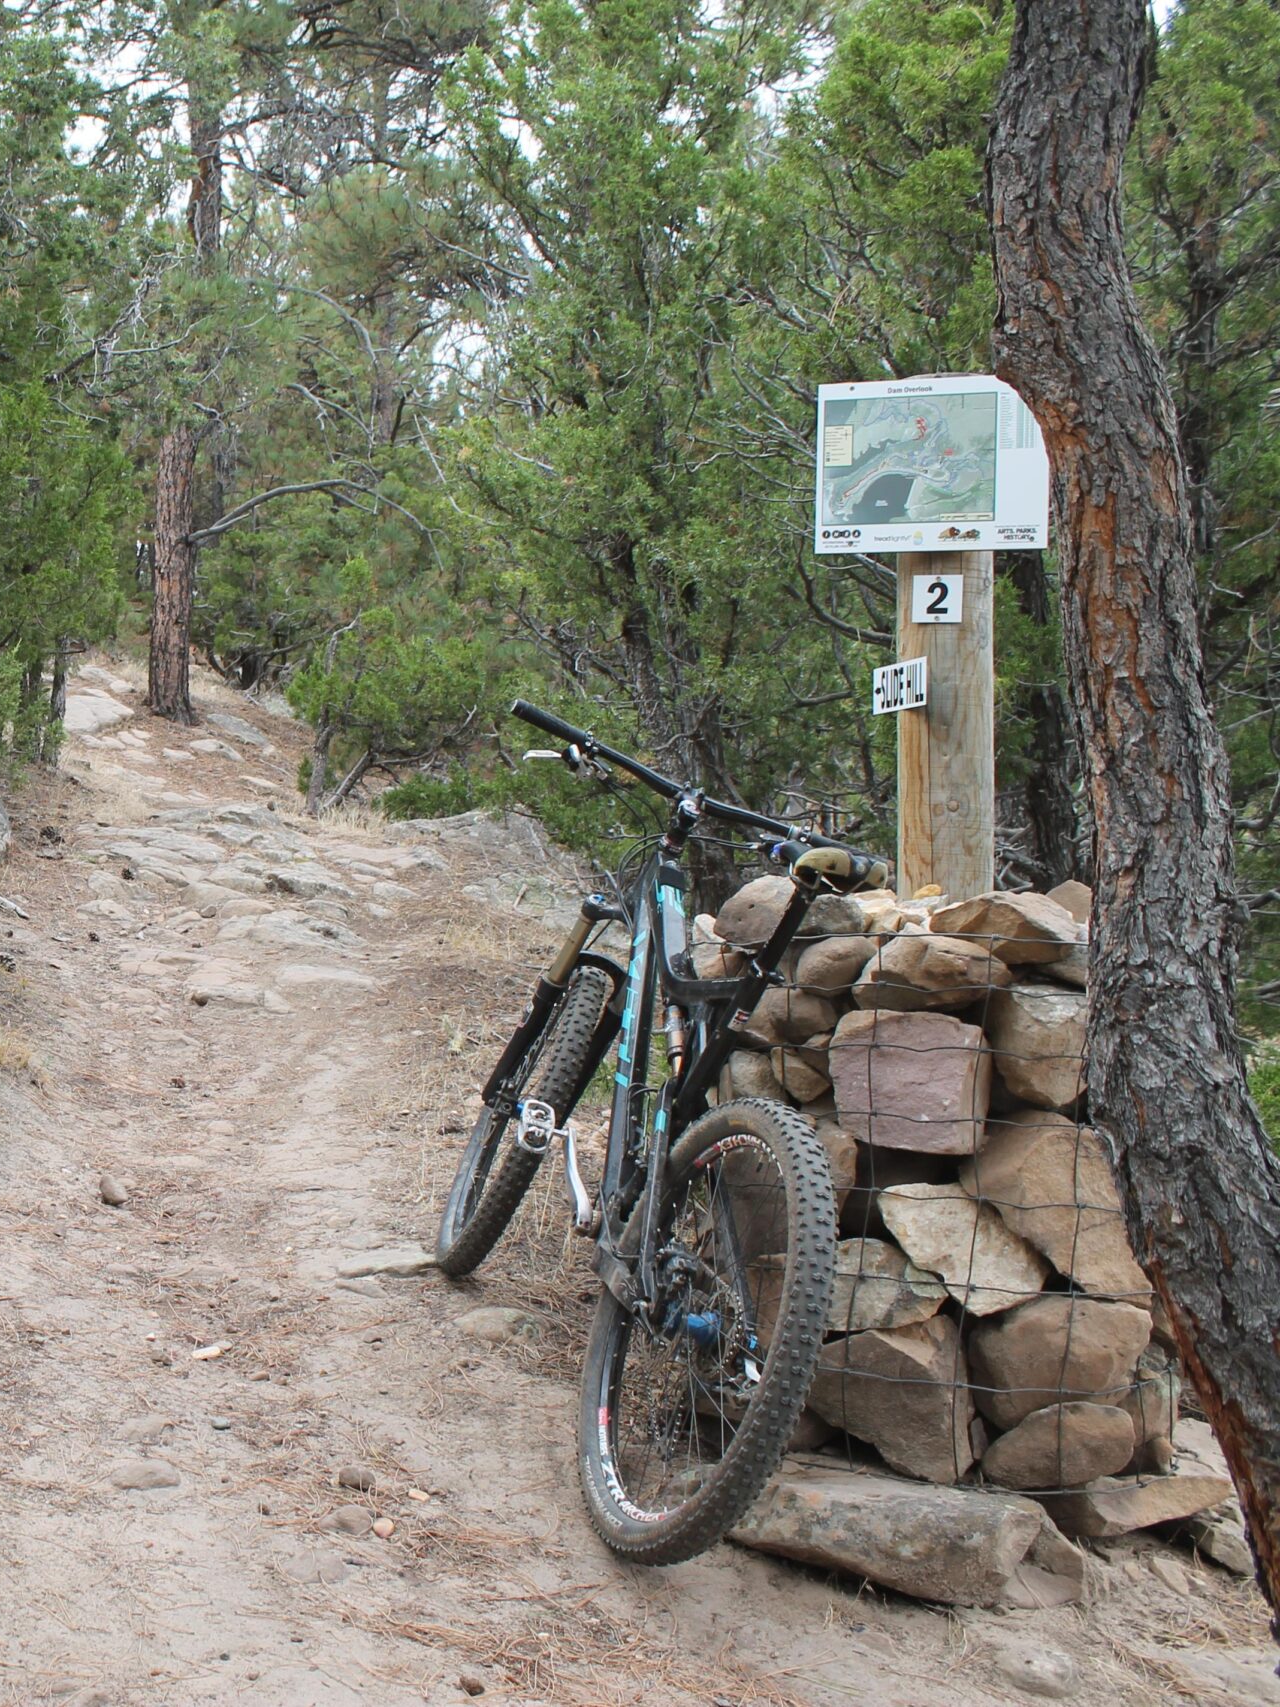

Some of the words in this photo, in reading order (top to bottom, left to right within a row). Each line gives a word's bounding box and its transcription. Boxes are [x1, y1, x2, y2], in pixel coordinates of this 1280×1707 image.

[926, 582, 949, 614] 2
[881, 667, 904, 709] SLIDE
[906, 662, 924, 705] HILL
[601, 1461, 626, 1503] ZTR
